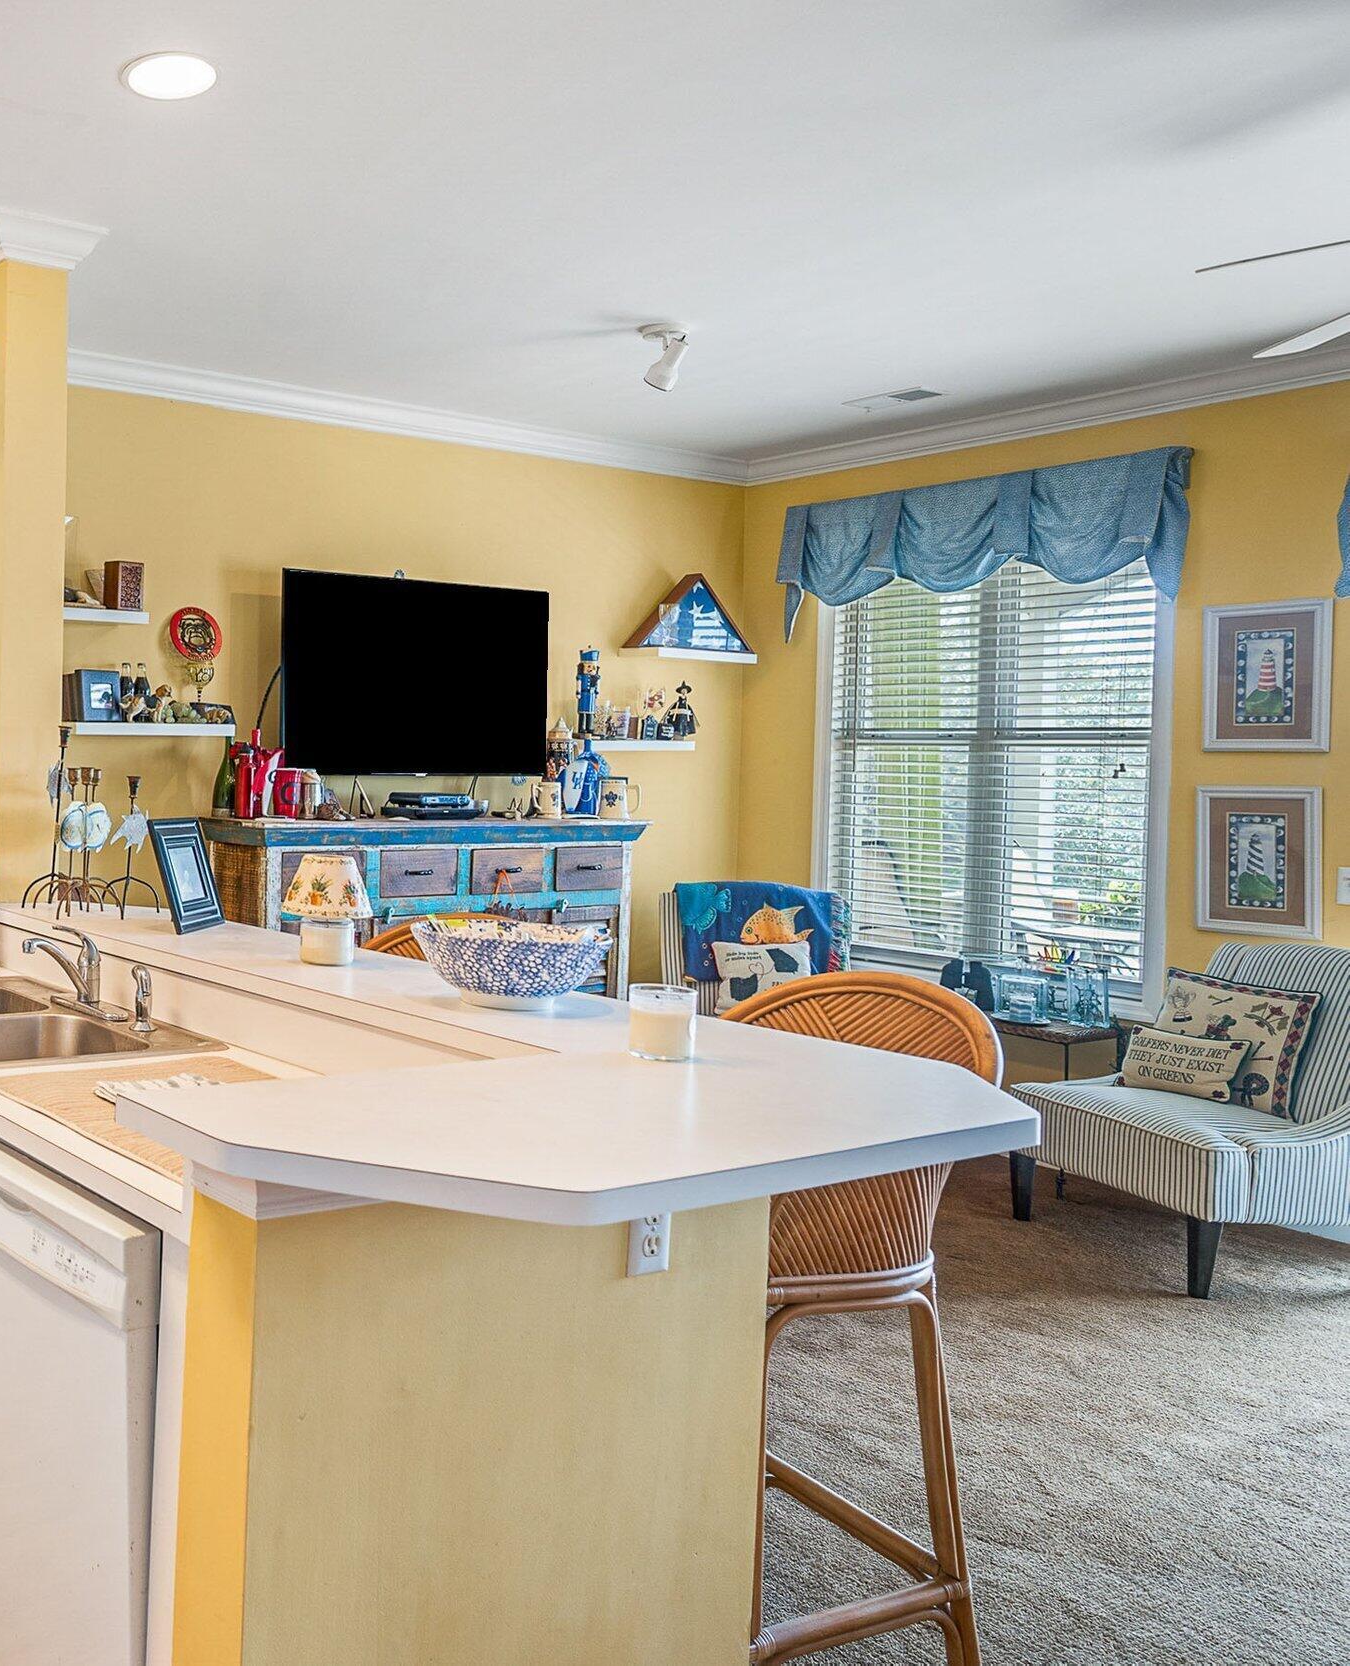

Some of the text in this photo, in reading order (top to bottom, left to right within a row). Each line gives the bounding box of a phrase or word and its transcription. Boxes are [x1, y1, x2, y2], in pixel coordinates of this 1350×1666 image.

[280, 781, 301, 806] G
[1132, 1036, 1232, 1060] GOLFERS NEVER DIET
[1129, 1049, 1225, 1074] THEY JUST EXIST
[1137, 1064, 1196, 1085] ON GREENS
